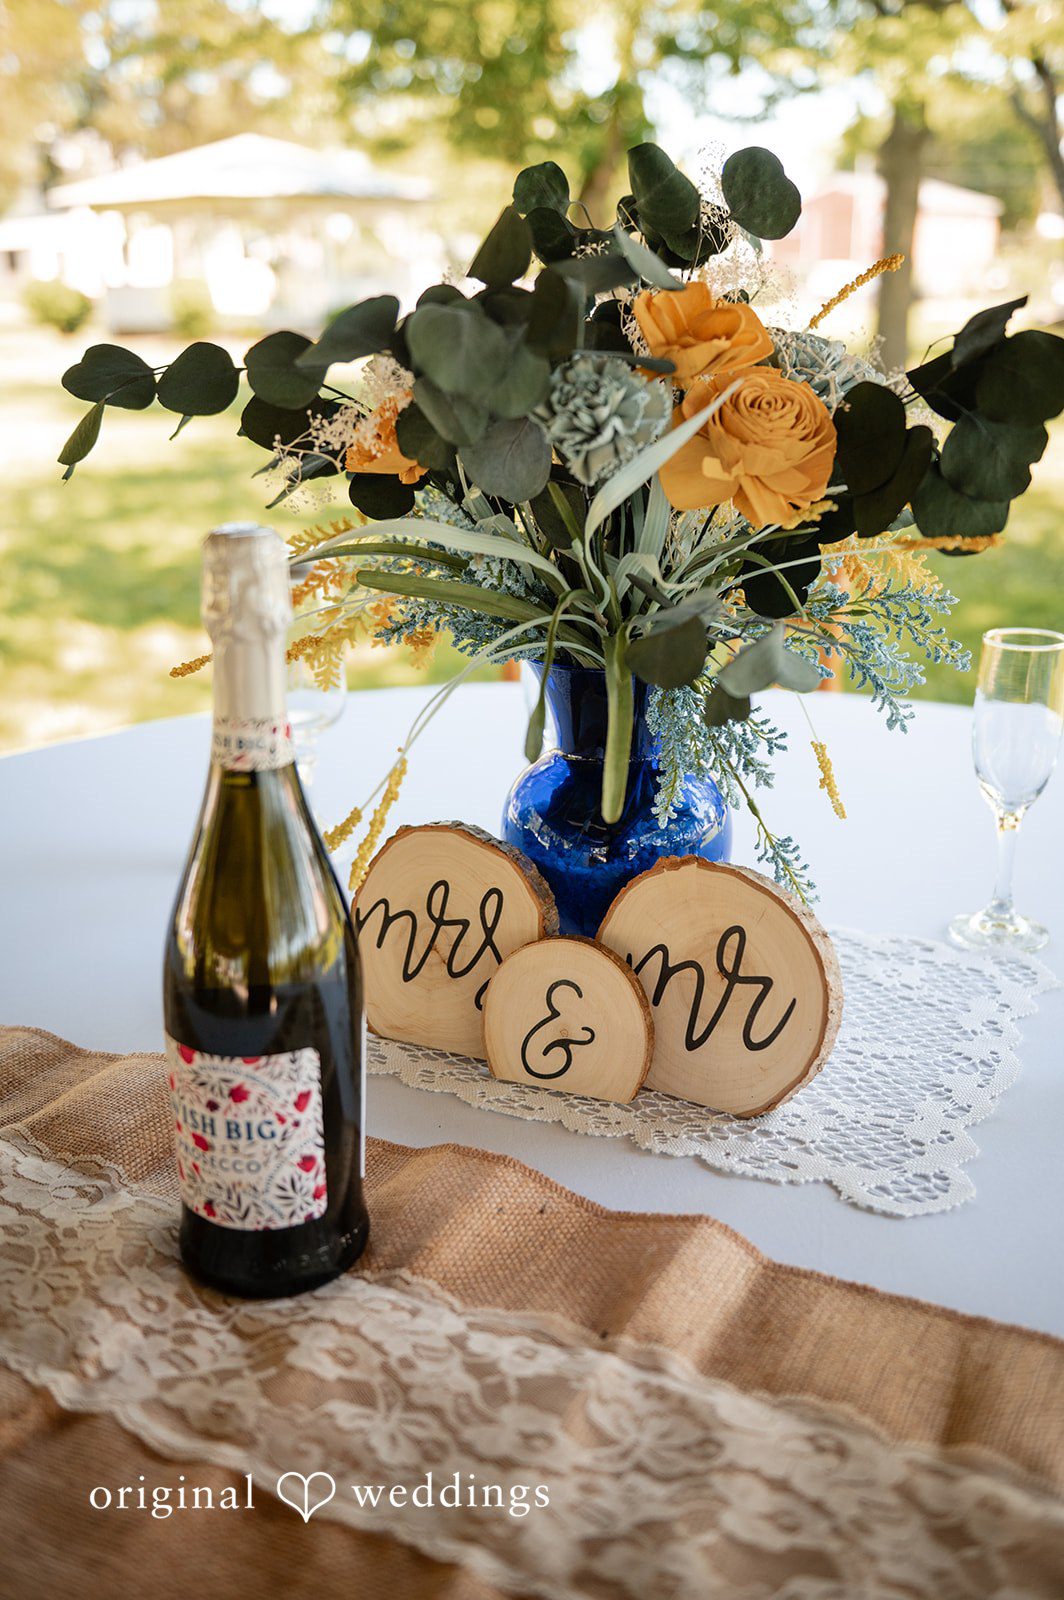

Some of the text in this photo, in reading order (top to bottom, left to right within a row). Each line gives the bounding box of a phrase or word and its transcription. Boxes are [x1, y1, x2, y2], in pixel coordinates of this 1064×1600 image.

[521, 979, 596, 1080] &
[626, 925, 797, 1052] mr
[225, 1119, 277, 1141] BIG
